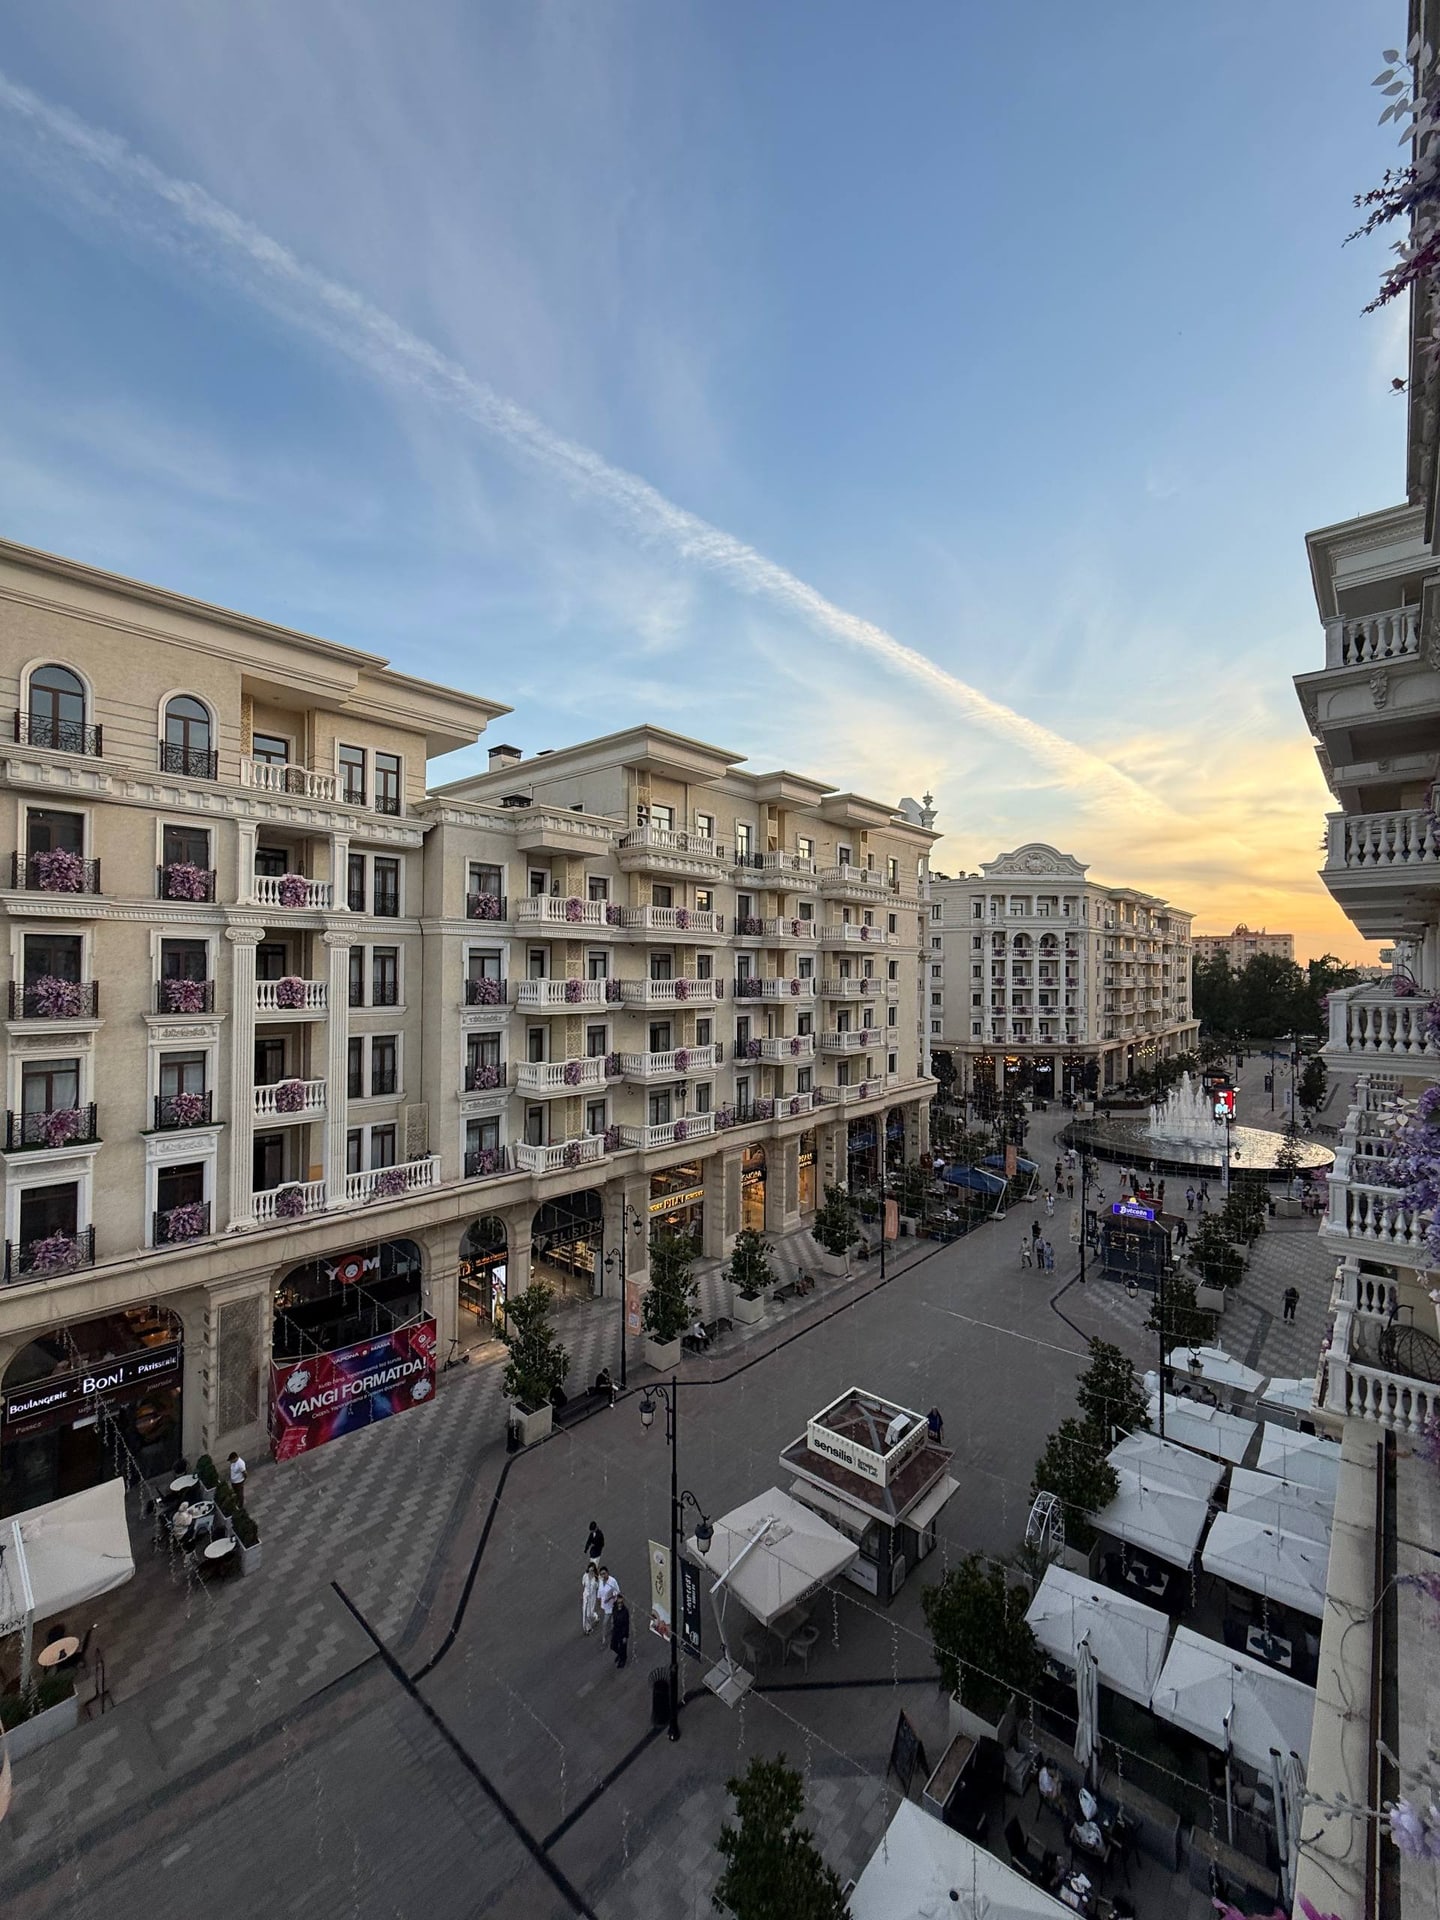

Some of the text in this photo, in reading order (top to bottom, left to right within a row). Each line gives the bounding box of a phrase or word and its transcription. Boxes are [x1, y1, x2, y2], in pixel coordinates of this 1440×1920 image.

[288, 1390, 339, 1418] YANGI
[342, 1356, 427, 1398] FORMATDA!
[813, 1438, 854, 1465] sensilis
